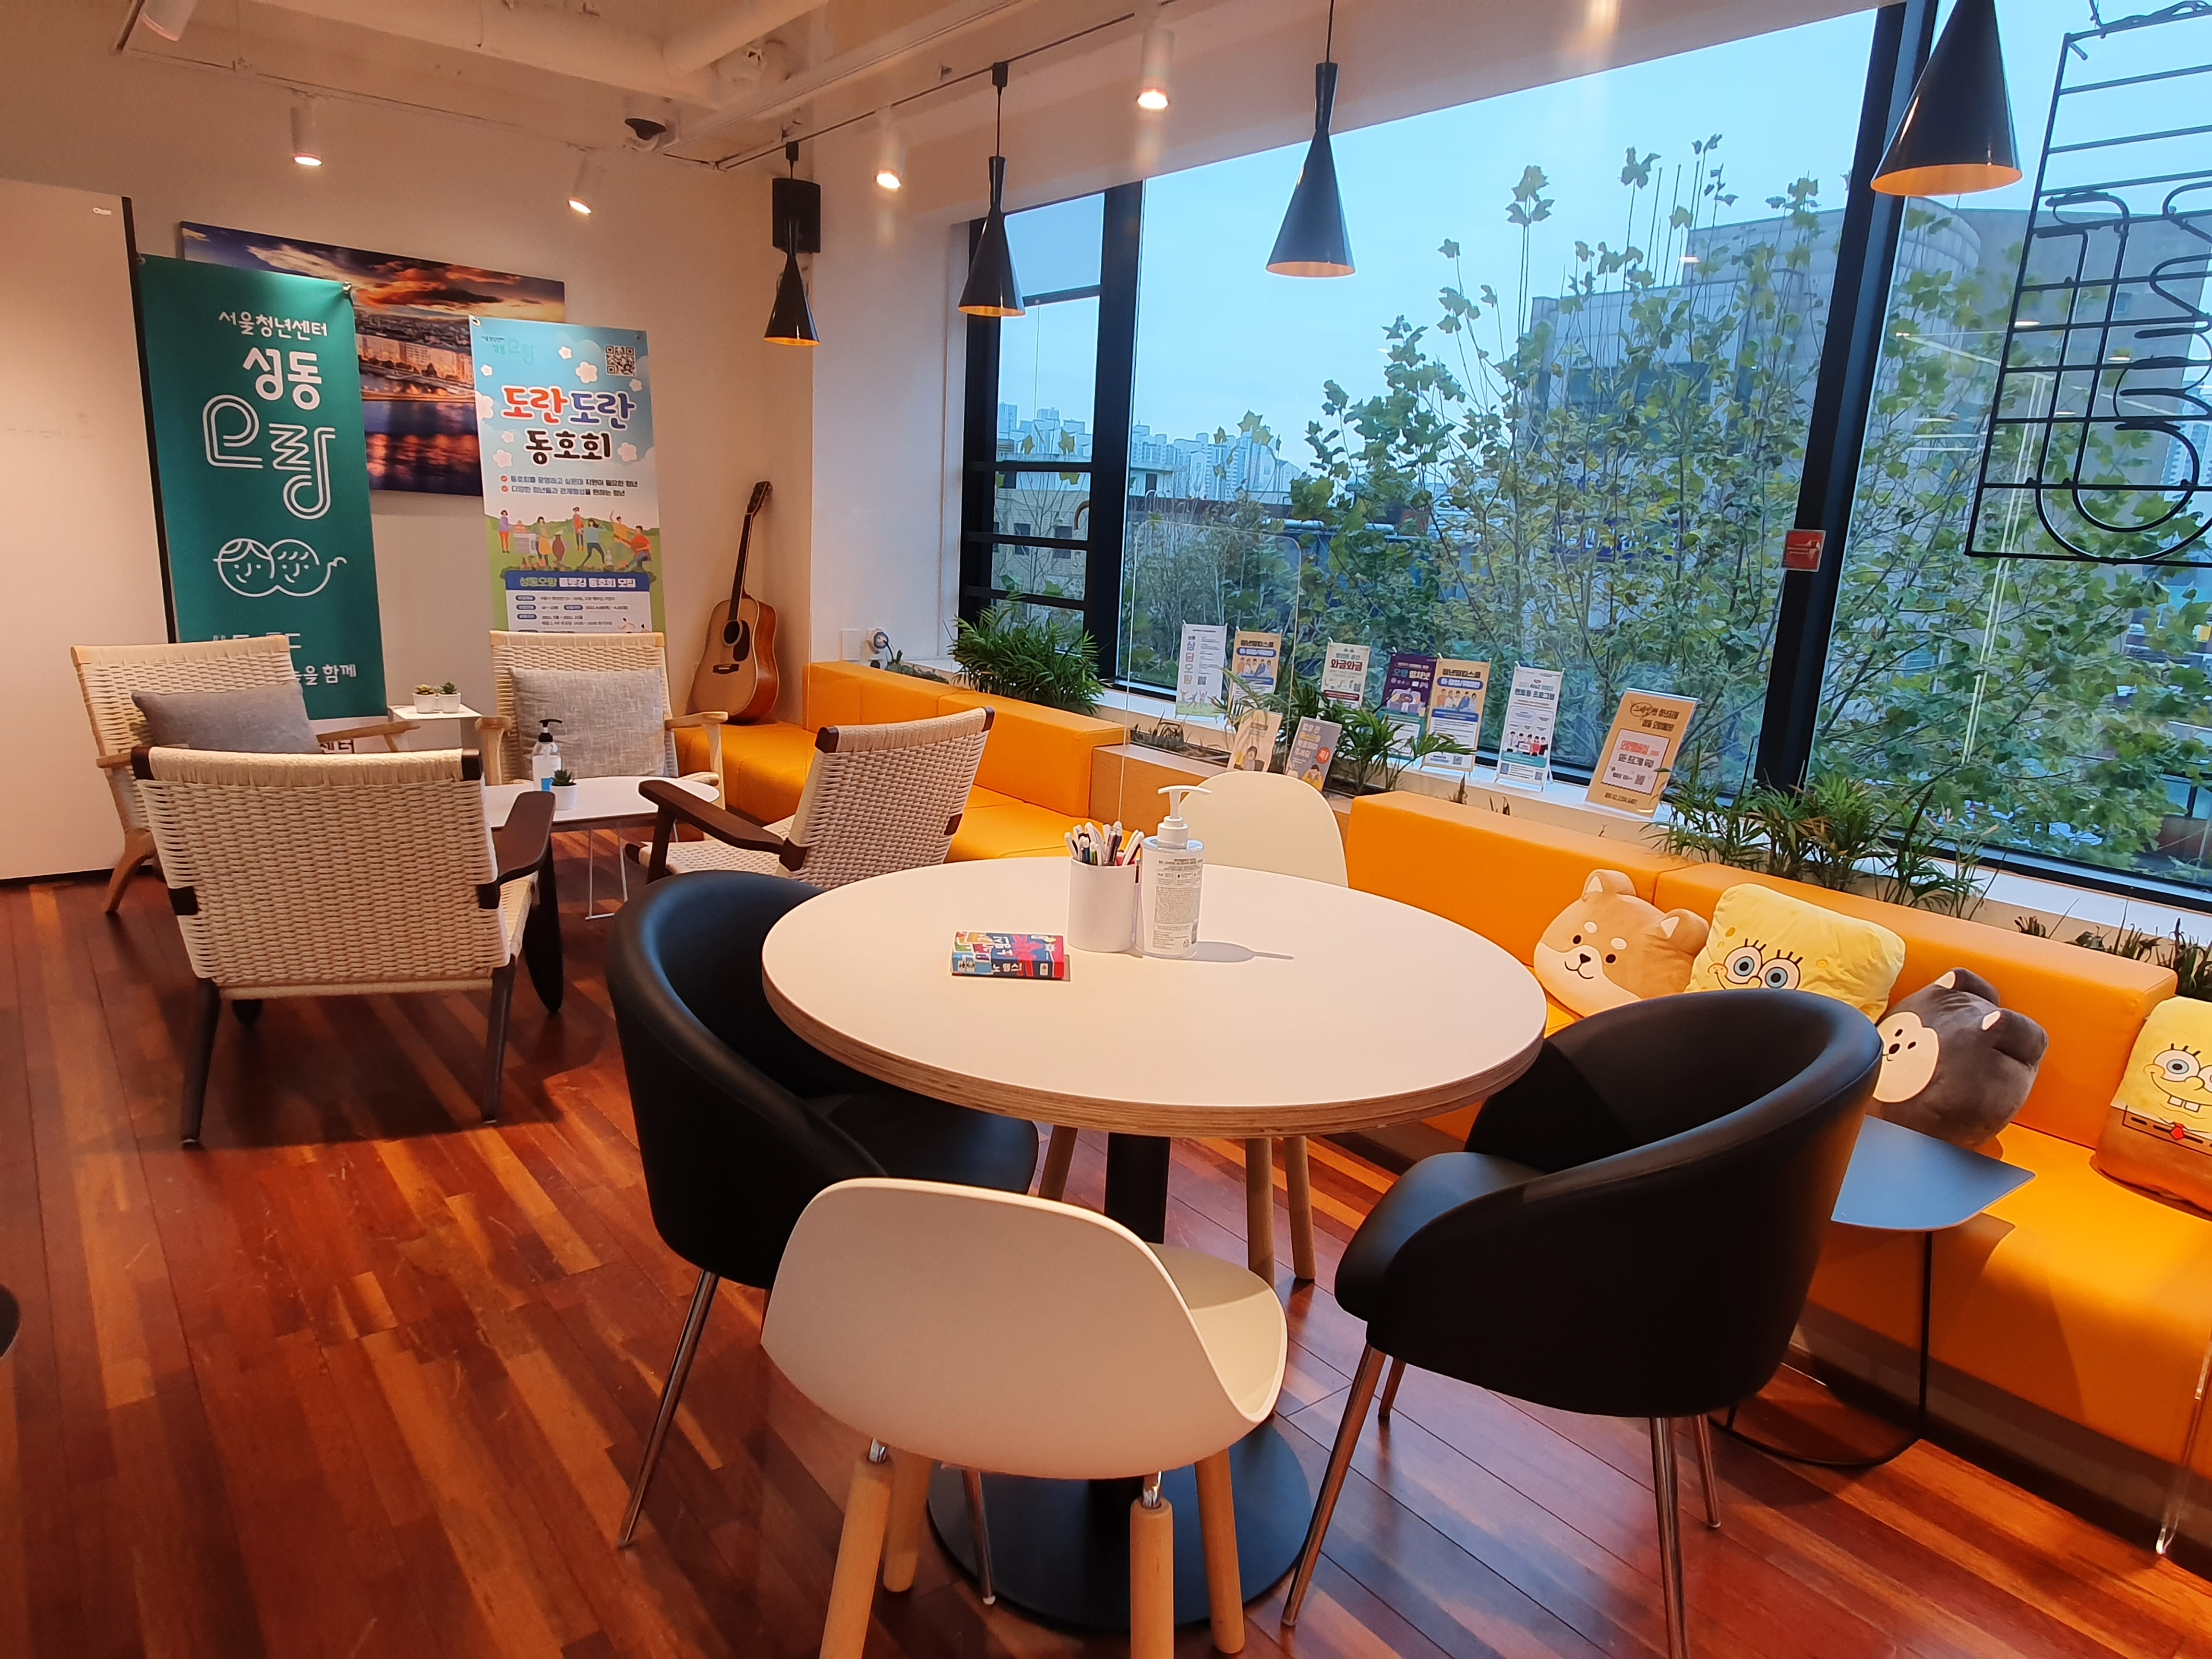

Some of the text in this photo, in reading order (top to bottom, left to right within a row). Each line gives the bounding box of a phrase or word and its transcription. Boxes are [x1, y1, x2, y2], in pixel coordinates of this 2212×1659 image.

[218, 312, 327, 341] 서울청년센터
[242, 347, 322, 410] 성동
[525, 430, 611, 465] 동호회
[322, 664, 356, 684] 함께
[993, 964, 1001, 972] 노
